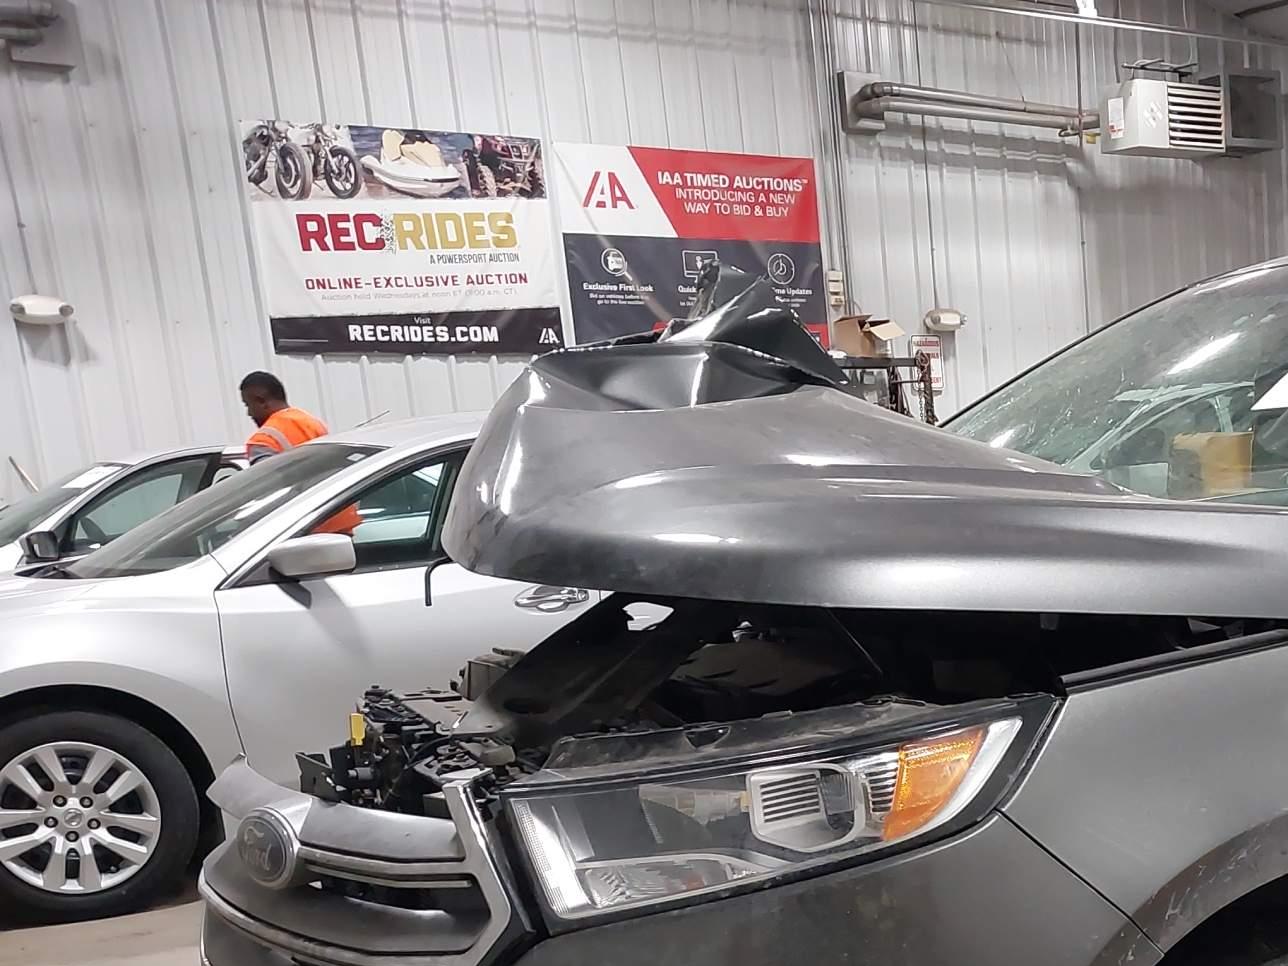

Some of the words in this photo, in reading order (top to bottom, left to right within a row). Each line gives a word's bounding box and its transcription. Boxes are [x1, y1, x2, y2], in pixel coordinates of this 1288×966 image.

[658, 171, 682, 185] IAA
[684, 173, 729, 187] TIMED
[583, 171, 637, 209] IAA
[675, 187, 754, 202] INTRODUCING
[758, 192, 766, 202] A
[769, 193, 796, 204] NEW
[684, 203, 711, 214] WAY
[714, 204, 730, 215] TO
[733, 204, 752, 215] BID
[755, 205, 764, 216] &
[766, 206, 789, 217] BUY
[296, 213, 386, 252] REC
[392, 213, 518, 251] RIDES
[429, 254, 436, 264] A
[437, 253, 487, 265] POWERSPORT
[488, 253, 520, 263] AUCTION
[305, 275, 460, 290] ONLINE-EXCLUSIVE
[466, 273, 528, 285] AUCTION
[583, 283, 617, 291] Exclusive
[619, 283, 635, 292] First
[786, 288, 812, 297] Updates
[414, 316, 431, 324] Visit
[348, 325, 499, 342] RECRIDES.COM
[243, 826, 272, 871] Ford
